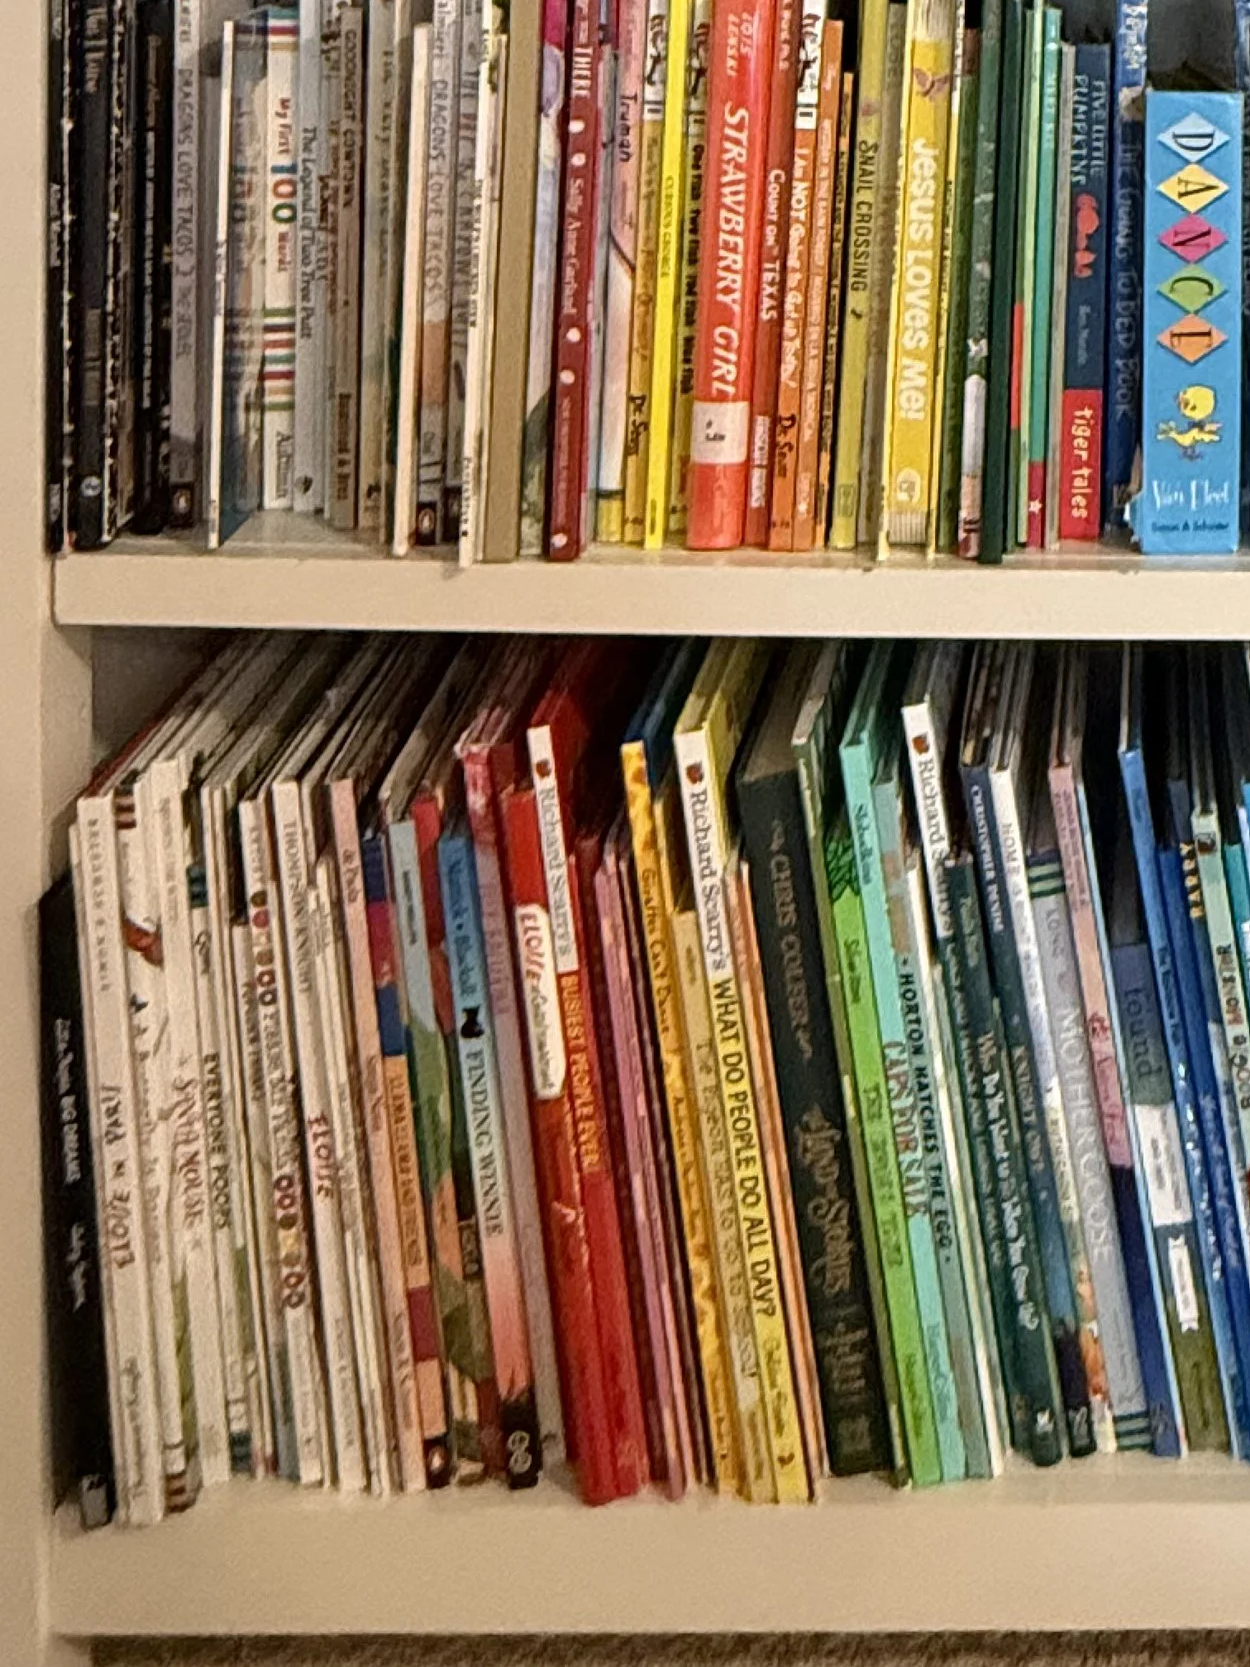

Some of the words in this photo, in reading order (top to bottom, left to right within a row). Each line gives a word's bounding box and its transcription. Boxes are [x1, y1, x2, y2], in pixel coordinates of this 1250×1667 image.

[572, 46, 592, 98] THERE
[303, 127, 317, 152] The
[431, 79, 448, 160] DRAGONS
[618, 94, 638, 163] Truman
[177, 152, 192, 200] LOVE
[275, 165, 297, 224] 100
[428, 171, 446, 221] LOVE
[562, 179, 585, 219] Sally
[766, 169, 785, 218] COUNT
[853, 140, 877, 195] SNAIL
[906, 138, 940, 241] Jesus
[176, 206, 192, 257] TACOS
[715, 102, 750, 312] STRAWBERRY
[565, 222, 582, 256] Anne
[850, 200, 873, 292] CROSSING
[1169, 130, 1218, 349] DANCE
[759, 260, 780, 322] TEXAS
[903, 249, 934, 352] Loves
[1117, 299, 1138, 346] BED
[711, 326, 740, 396] GIRL
[899, 359, 929, 419] Me!
[1116, 357, 1137, 420] BOOK
[1068, 407, 1095, 460] tiger
[1069, 466, 1095, 518] tales
[918, 758, 948, 843] Richard
[690, 791, 721, 880] Richard
[771, 853, 796, 926] CHRIS
[536, 788, 565, 867] Richard
[570, 1054, 594, 1119] PEOPLE
[713, 978, 737, 1045] WHAT
[899, 974, 925, 1056] HORTON
[467, 1050, 493, 1149] FINDING
[724, 1052, 743, 1085] DO
[203, 1053, 226, 1154] EVERYONE
[728, 1091, 758, 1171] PEOPLE
[914, 1066, 939, 1154] HATCHES
[1055, 1005, 1098, 1144] MOTHER
[1081, 1153, 1114, 1262] GOOSE
[211, 1165, 230, 1229] POOPS
[475, 1154, 503, 1236] WINNIE
[741, 1176, 759, 1208] DO
[929, 1164, 946, 1198] THE
[744, 1215, 769, 1252] ALL
[934, 1209, 953, 1250] EGG
[749, 1260, 776, 1317] DAY?
